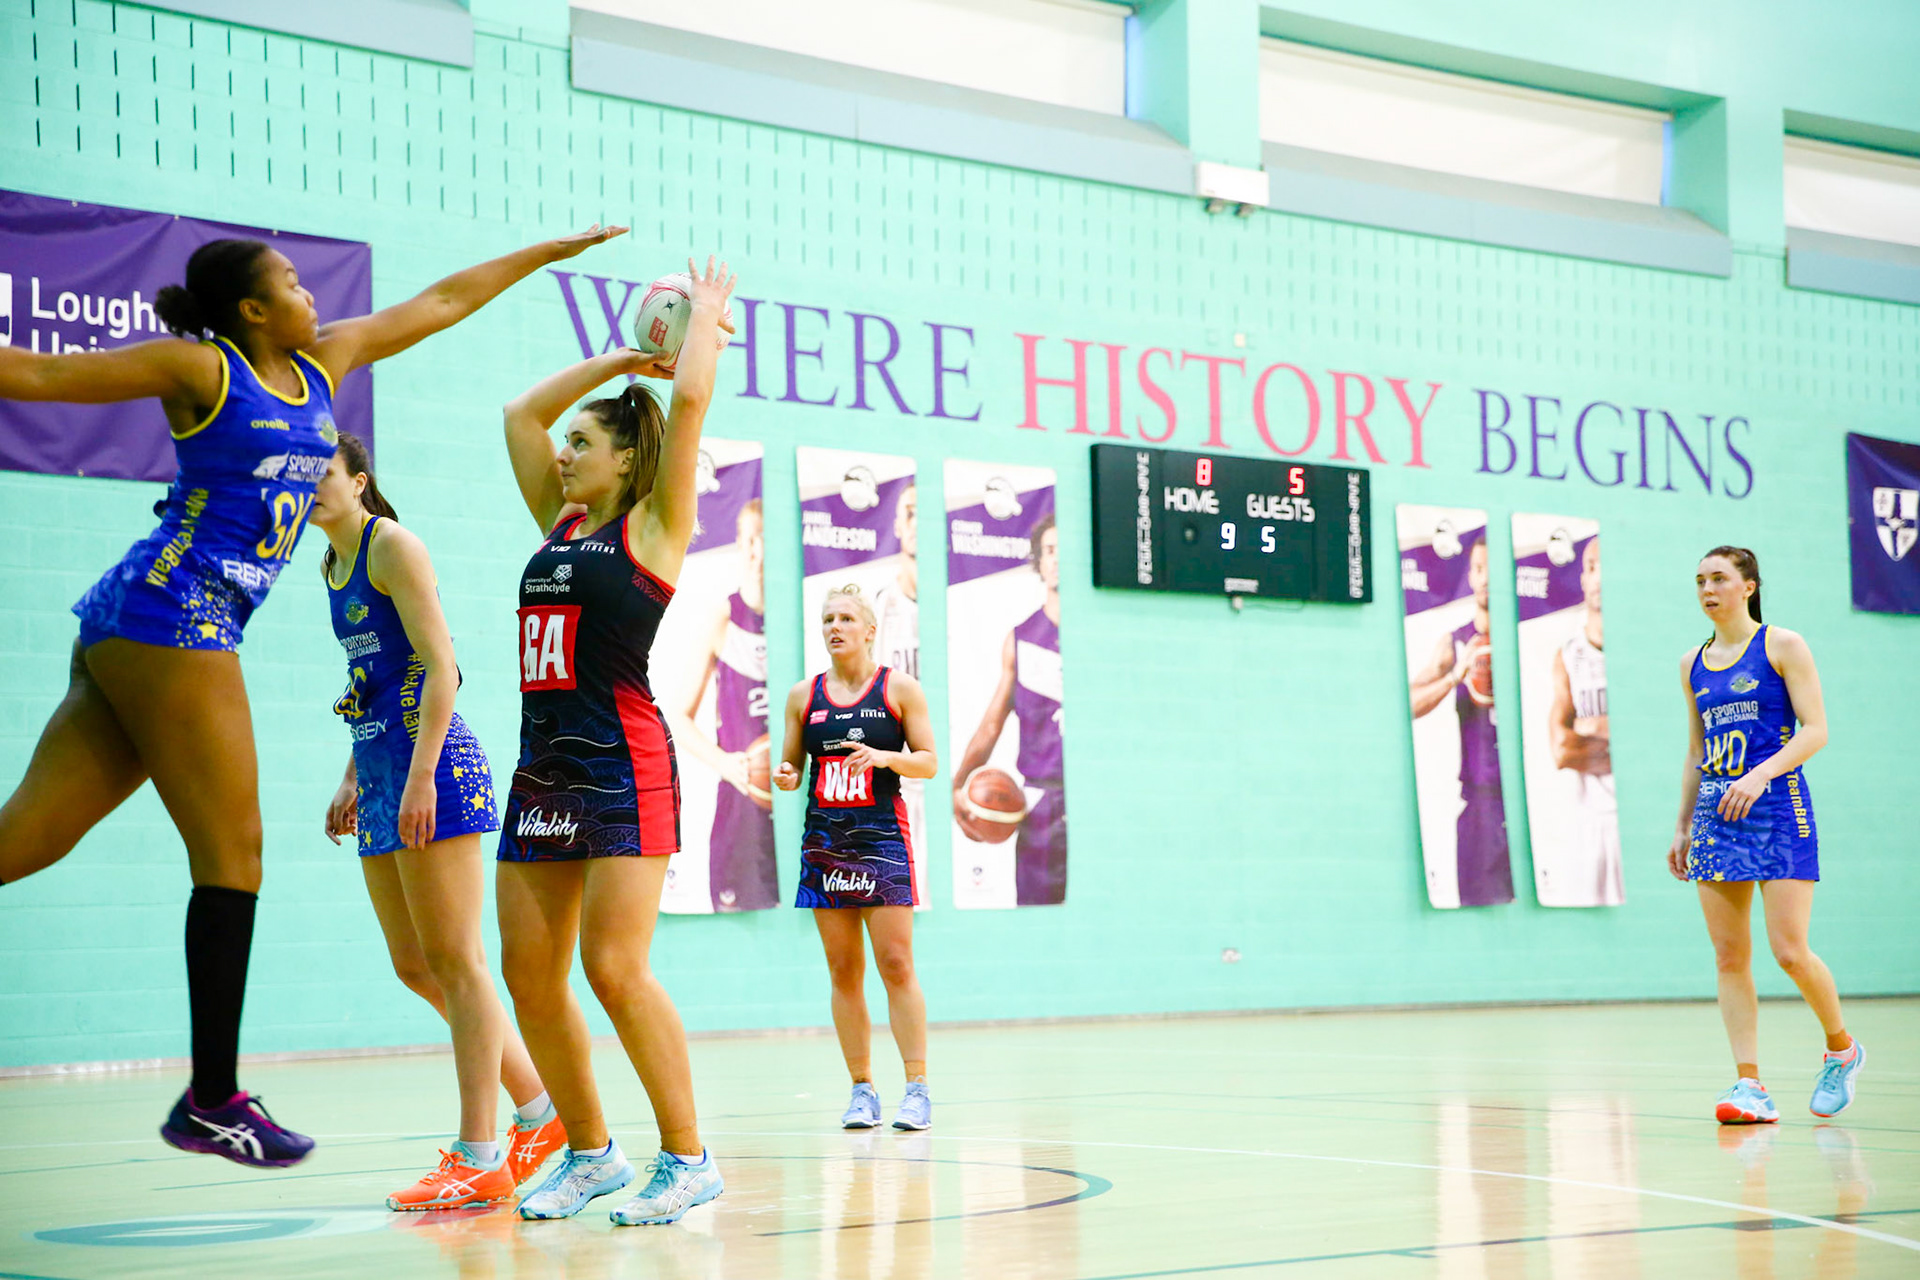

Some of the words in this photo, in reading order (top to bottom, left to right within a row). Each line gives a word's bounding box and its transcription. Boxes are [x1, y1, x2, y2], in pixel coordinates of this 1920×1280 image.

[547, 269, 984, 423] WHERE
[1014, 333, 1443, 469] HISTORY
[1474, 389, 1756, 500] BEGINS
[1289, 467, 1304, 495] 5
[1164, 486, 1220, 515] HOME
[1246, 494, 1316, 523] GUESTS
[1221, 522, 1236, 550] 9
[1261, 526, 1276, 553] 5
[524, 583, 571, 595] Strathclyde
[523, 614, 569, 683] GA
[1711, 700, 1759, 720] SPORTING
[1702, 729, 1747, 777] WD
[823, 761, 867, 802] WA
[517, 806, 578, 845] Vitality
[822, 869, 877, 898] Vitality
